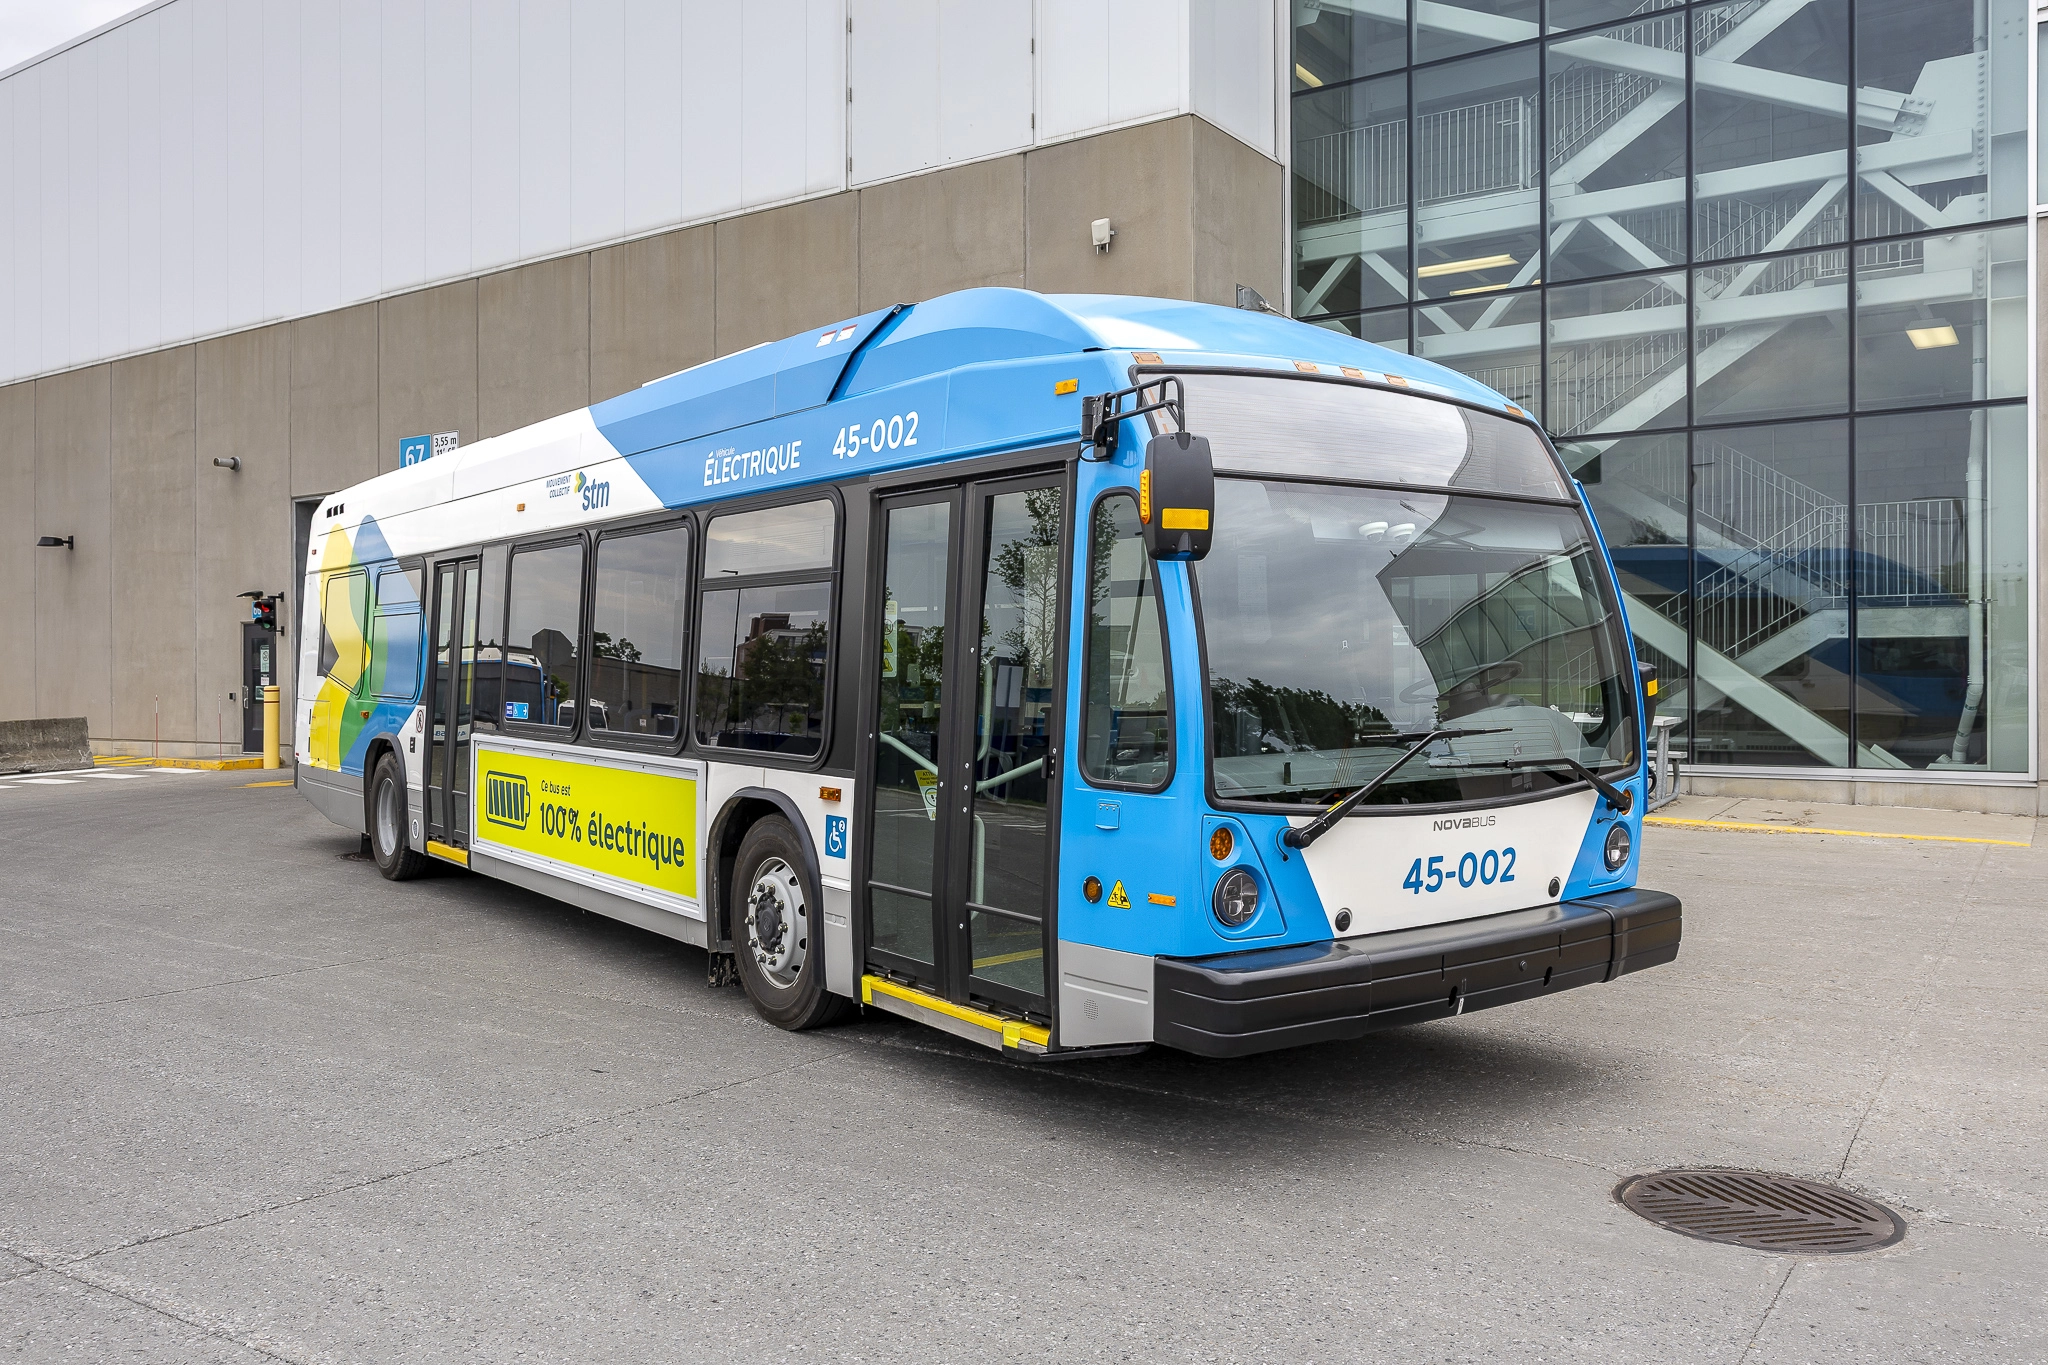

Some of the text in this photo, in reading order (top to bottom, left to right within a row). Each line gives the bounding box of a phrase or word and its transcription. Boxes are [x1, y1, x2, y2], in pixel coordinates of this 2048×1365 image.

[435, 436, 457, 447] 3,55 m
[832, 411, 919, 460] 45-002
[405, 444, 425, 466] 67
[715, 446, 736, 458] Véhicule
[703, 440, 802, 487] ÉLECTRIQUE
[546, 474, 572, 488] MOUVEMENT
[549, 485, 571, 498] COLLECTIF
[582, 478, 610, 511] stm
[540, 779, 571, 797] Ce bus est
[540, 801, 685, 870] 100% électrique
[1402, 846, 1516, 895] 45-002
